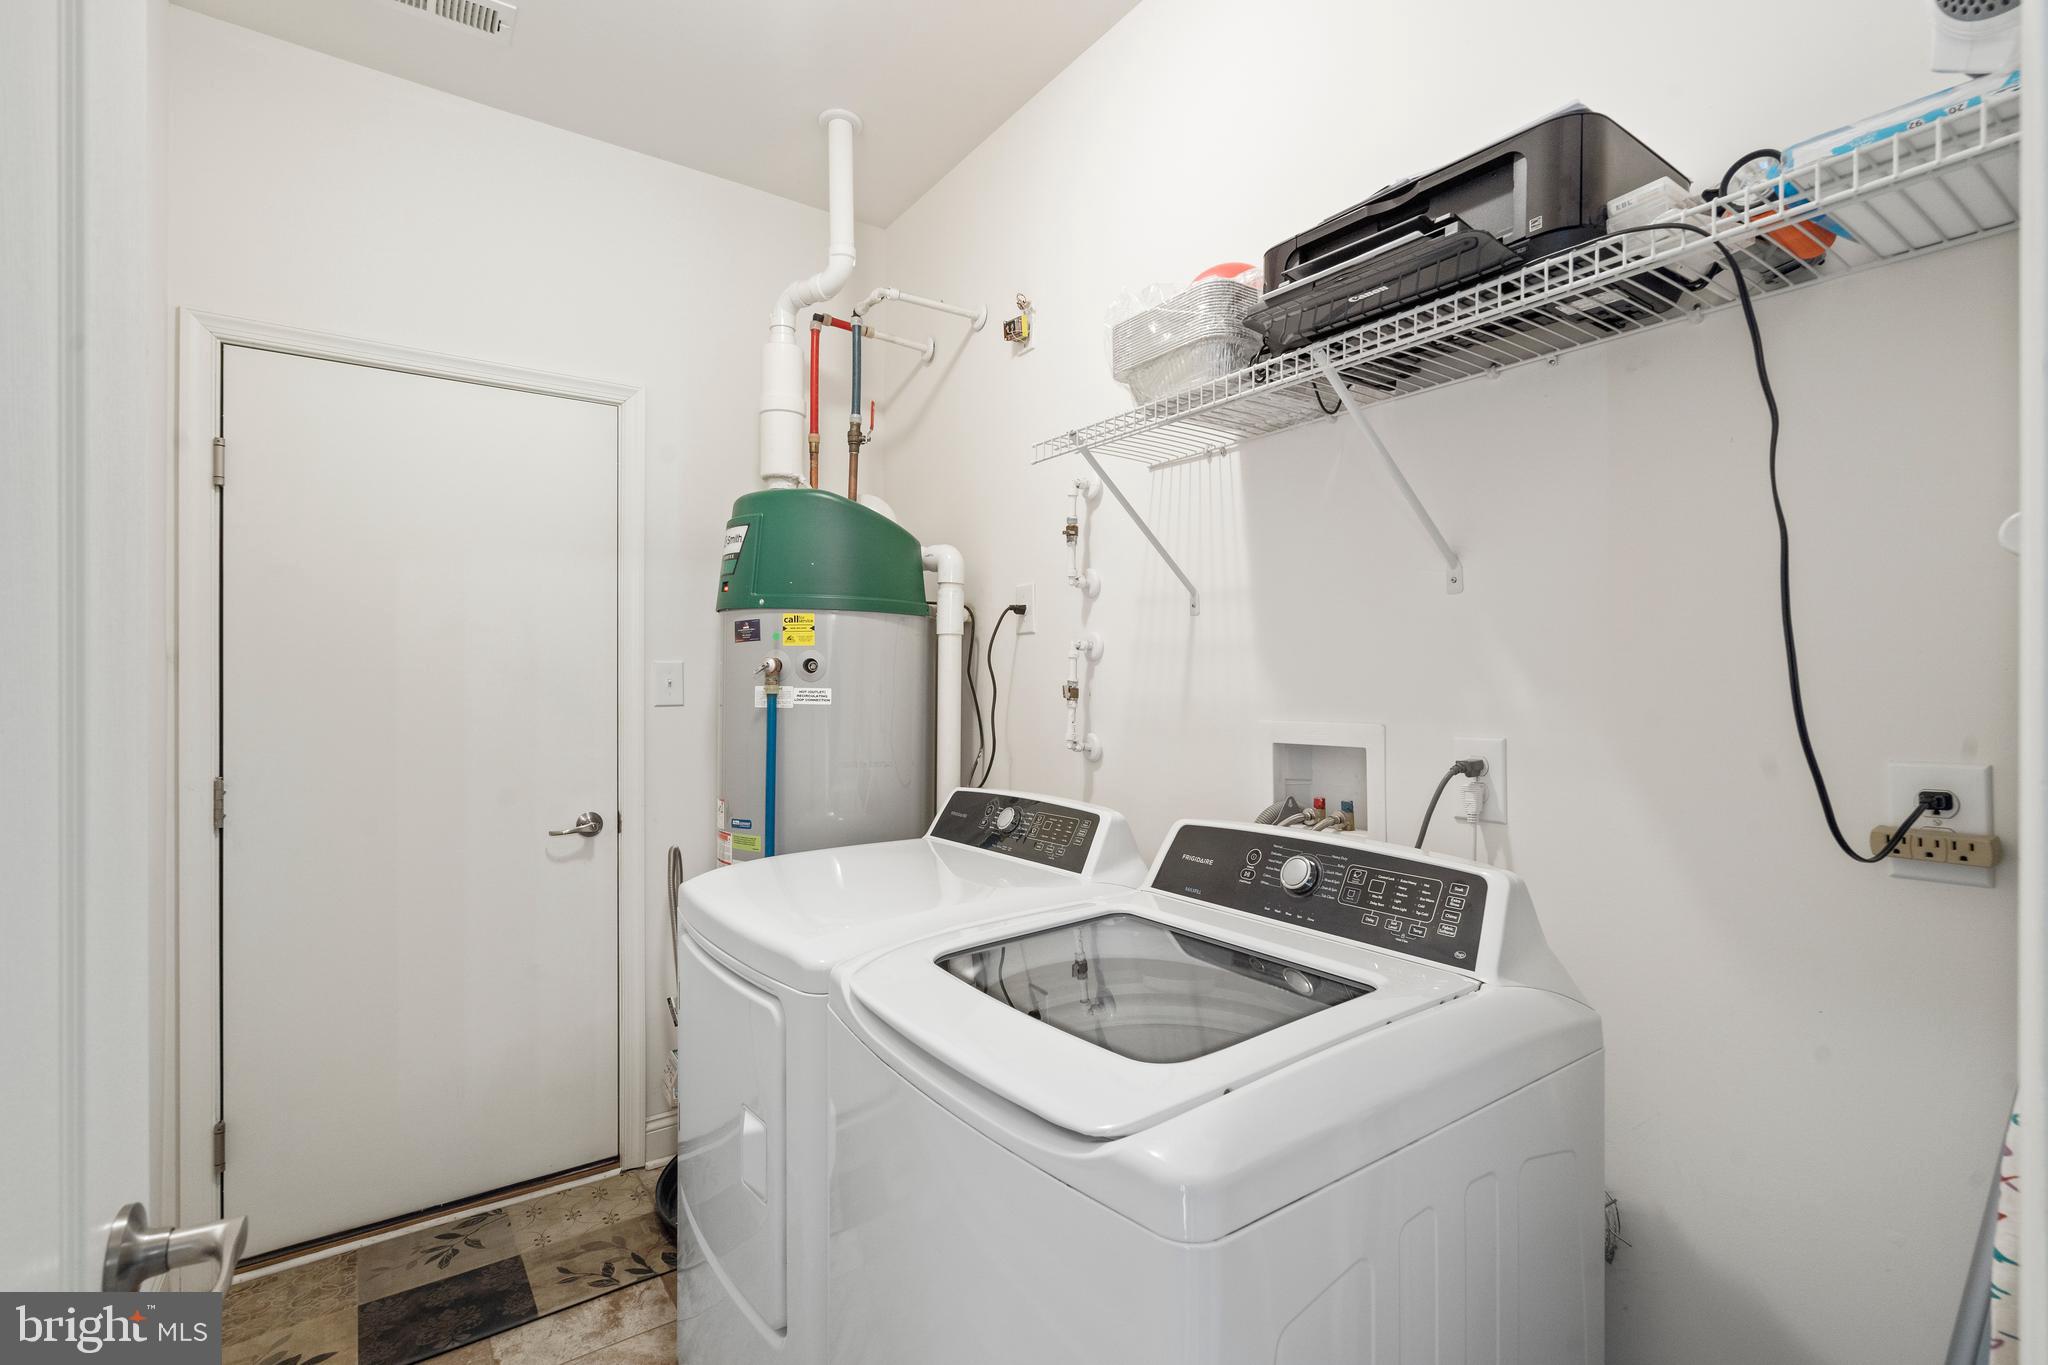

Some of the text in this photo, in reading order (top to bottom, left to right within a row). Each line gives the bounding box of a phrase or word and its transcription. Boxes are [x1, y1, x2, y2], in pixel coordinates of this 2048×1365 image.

[1348, 285, 1389, 302] Canon
[783, 615, 799, 624] call
[1182, 854, 1214, 865] FRIGIDAIRE
